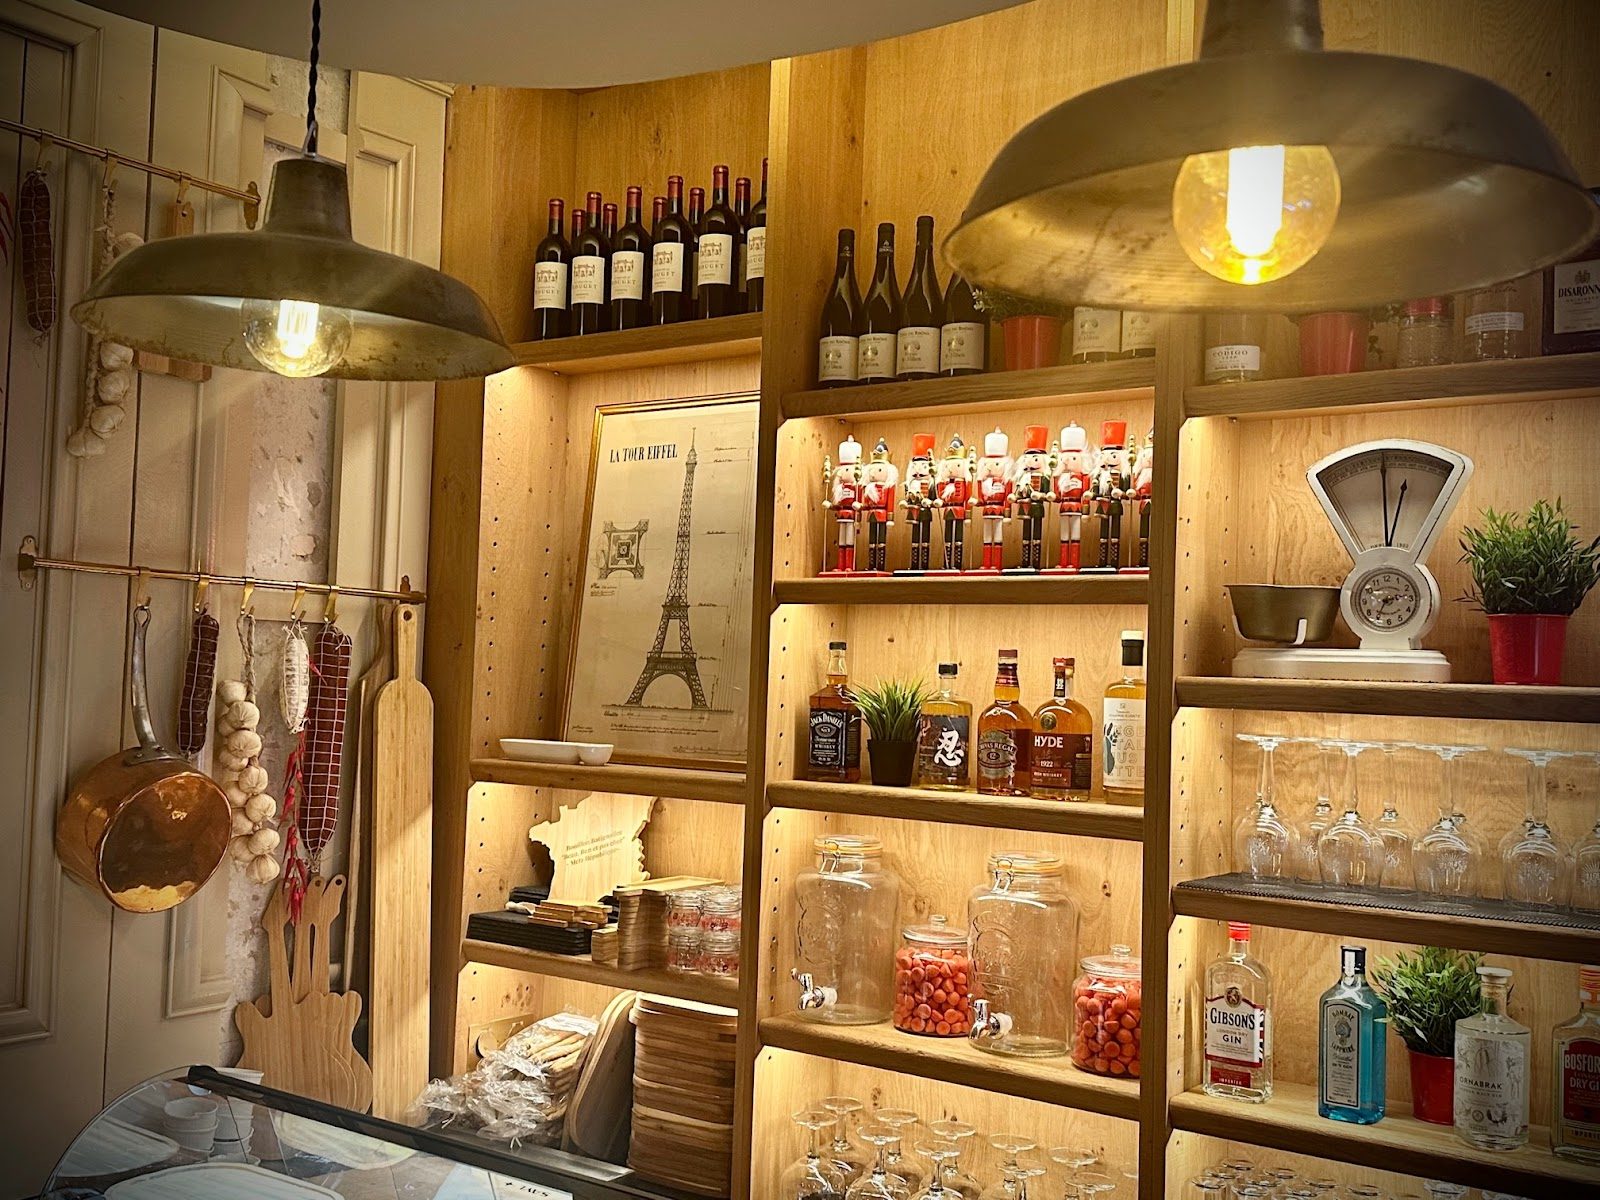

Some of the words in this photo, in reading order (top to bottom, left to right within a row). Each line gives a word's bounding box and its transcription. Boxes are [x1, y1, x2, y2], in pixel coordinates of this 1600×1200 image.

[1558, 283, 1600, 298] DISARONN
[609, 449, 620, 463] LA
[623, 446, 645, 462] TOUR
[647, 443, 678, 460] EIFFEL
[810, 715, 823, 727] JACK
[934, 727, 965, 767] 忍
[994, 742, 1014, 753] REGAL
[1034, 735, 1064, 748] HYDE
[1040, 760, 1053, 768] 1922
[1222, 1034, 1242, 1045] GIN
[1564, 1054, 1600, 1074] BOSFOR
[1459, 1076, 1503, 1090] ORNABRAK
[1569, 1076, 1588, 1089] DRY
[1589, 1080, 1600, 1091] GI
